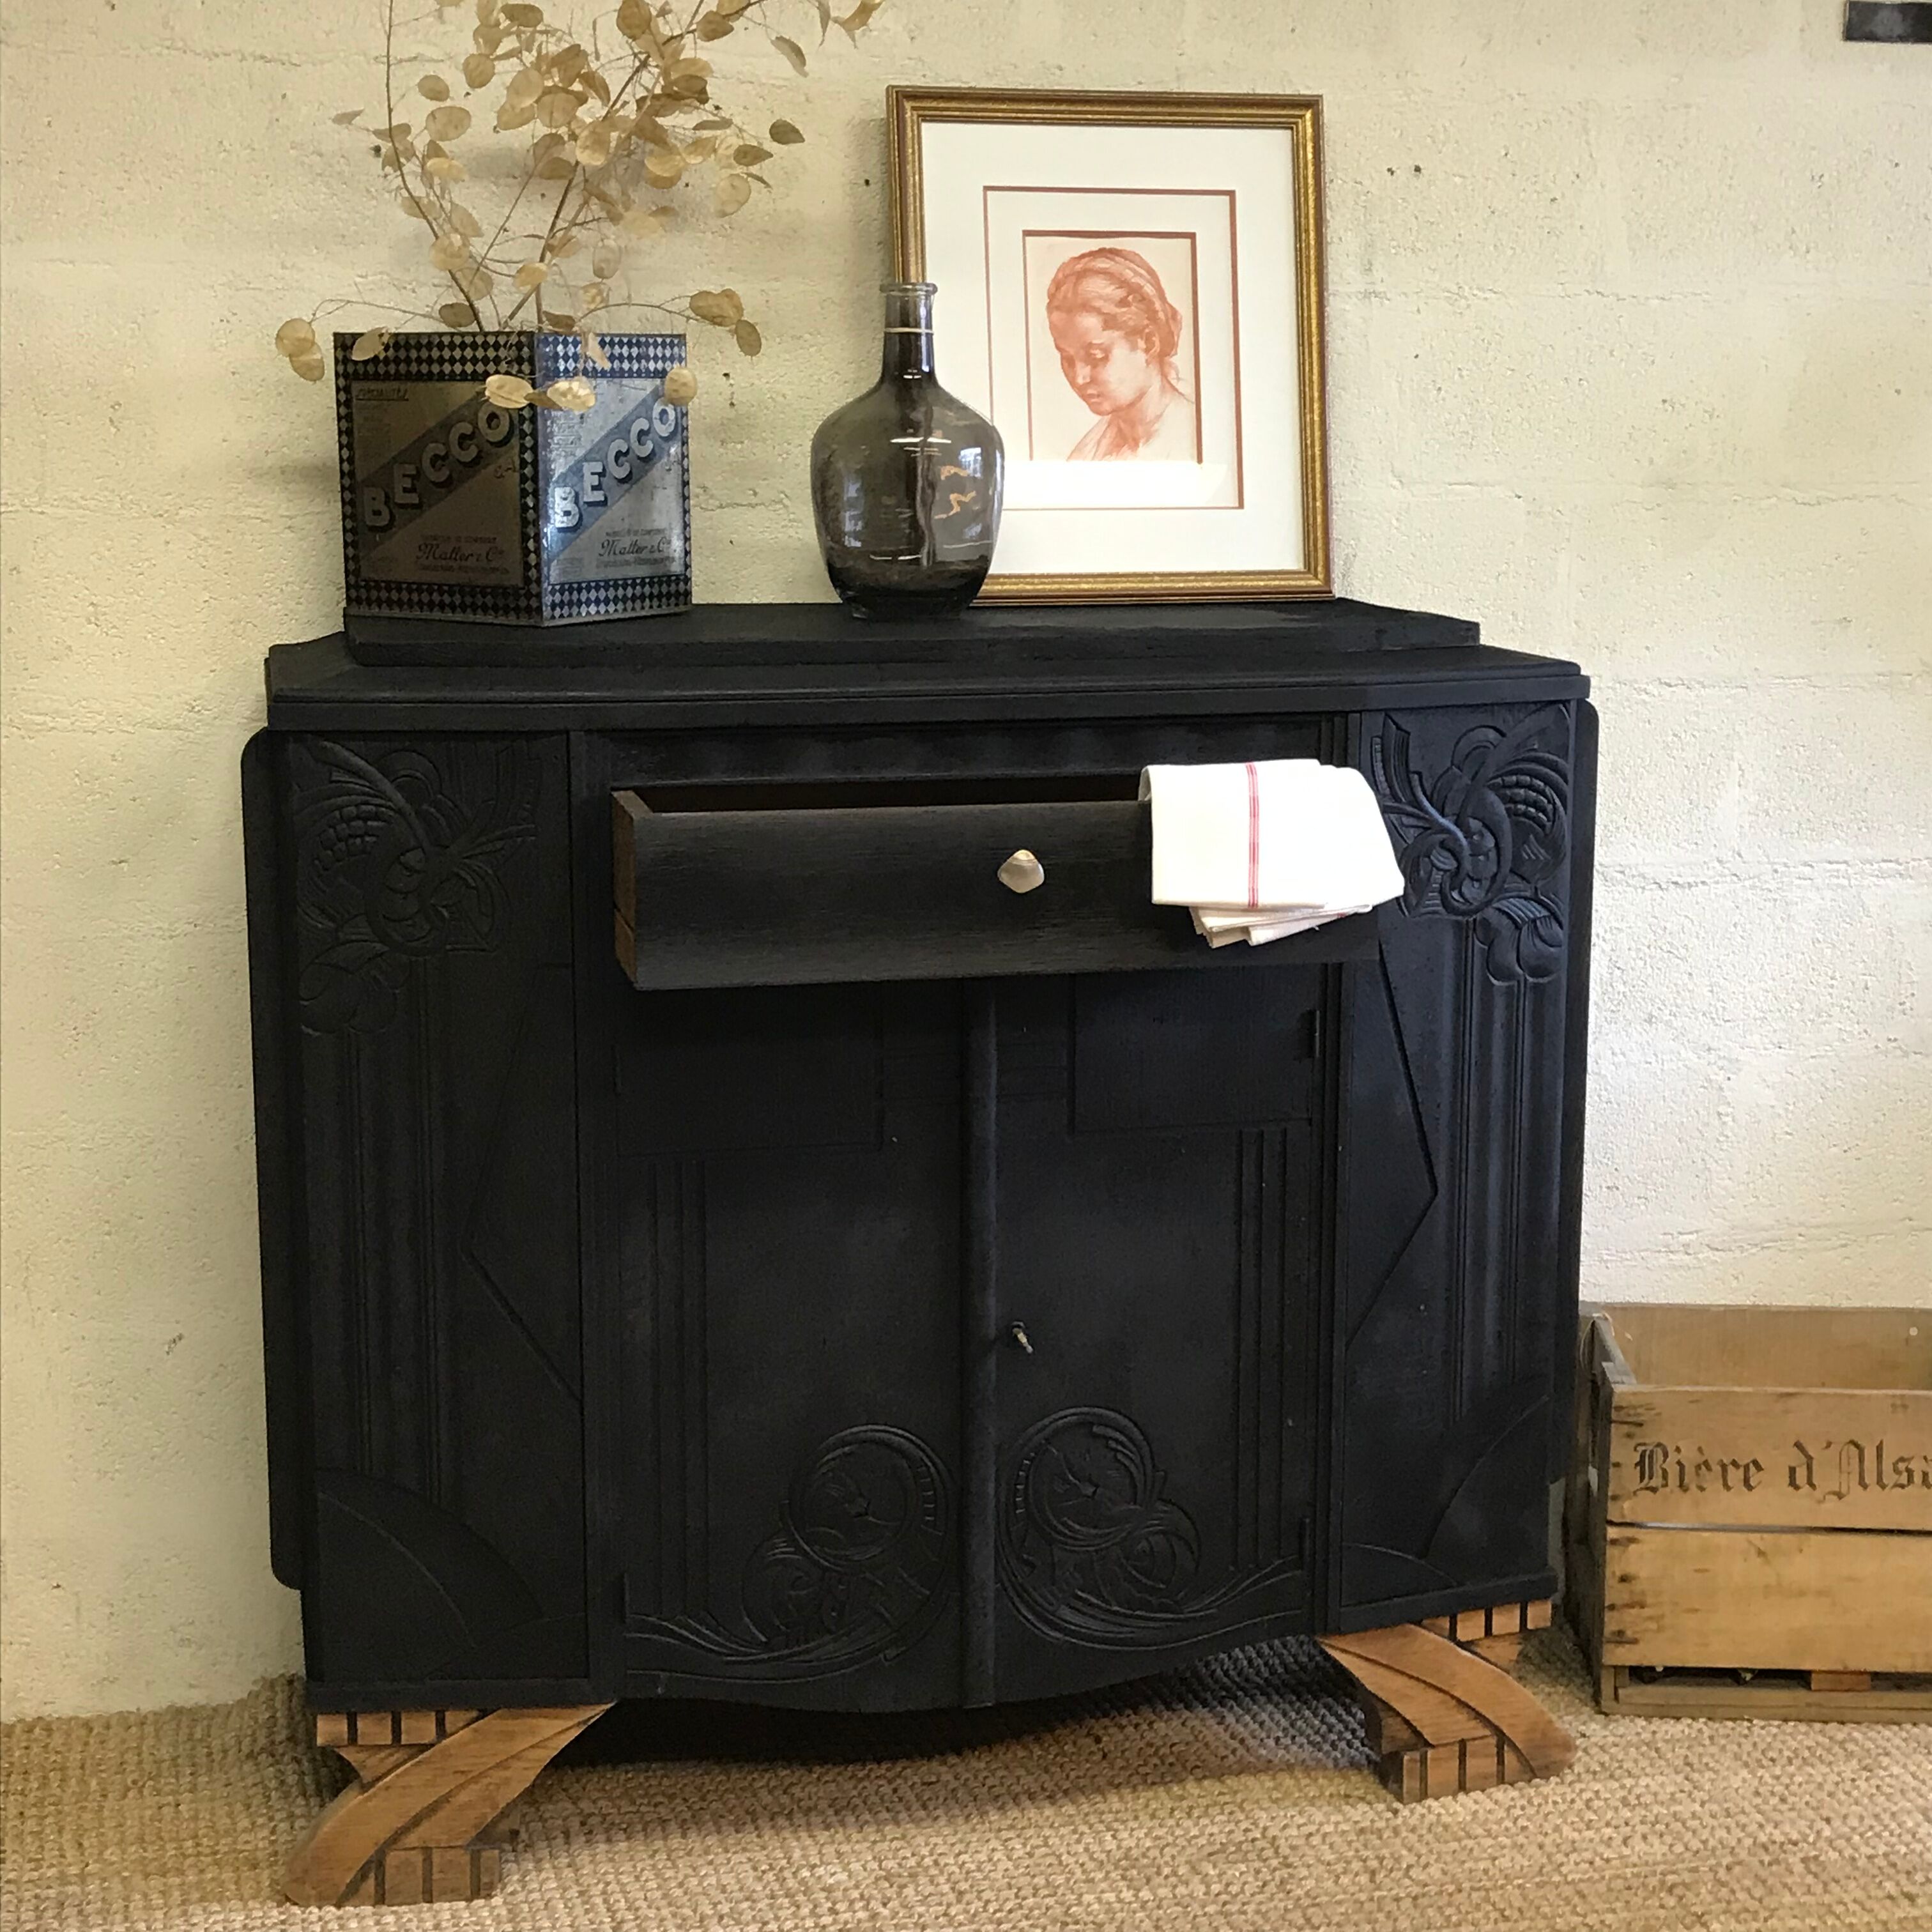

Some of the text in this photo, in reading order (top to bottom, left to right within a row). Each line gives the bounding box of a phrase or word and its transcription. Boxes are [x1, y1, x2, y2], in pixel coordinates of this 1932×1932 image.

[363, 401, 512, 528] BECCO
[554, 397, 677, 528] BECCO
[1632, 1441, 1764, 1496] Bière
